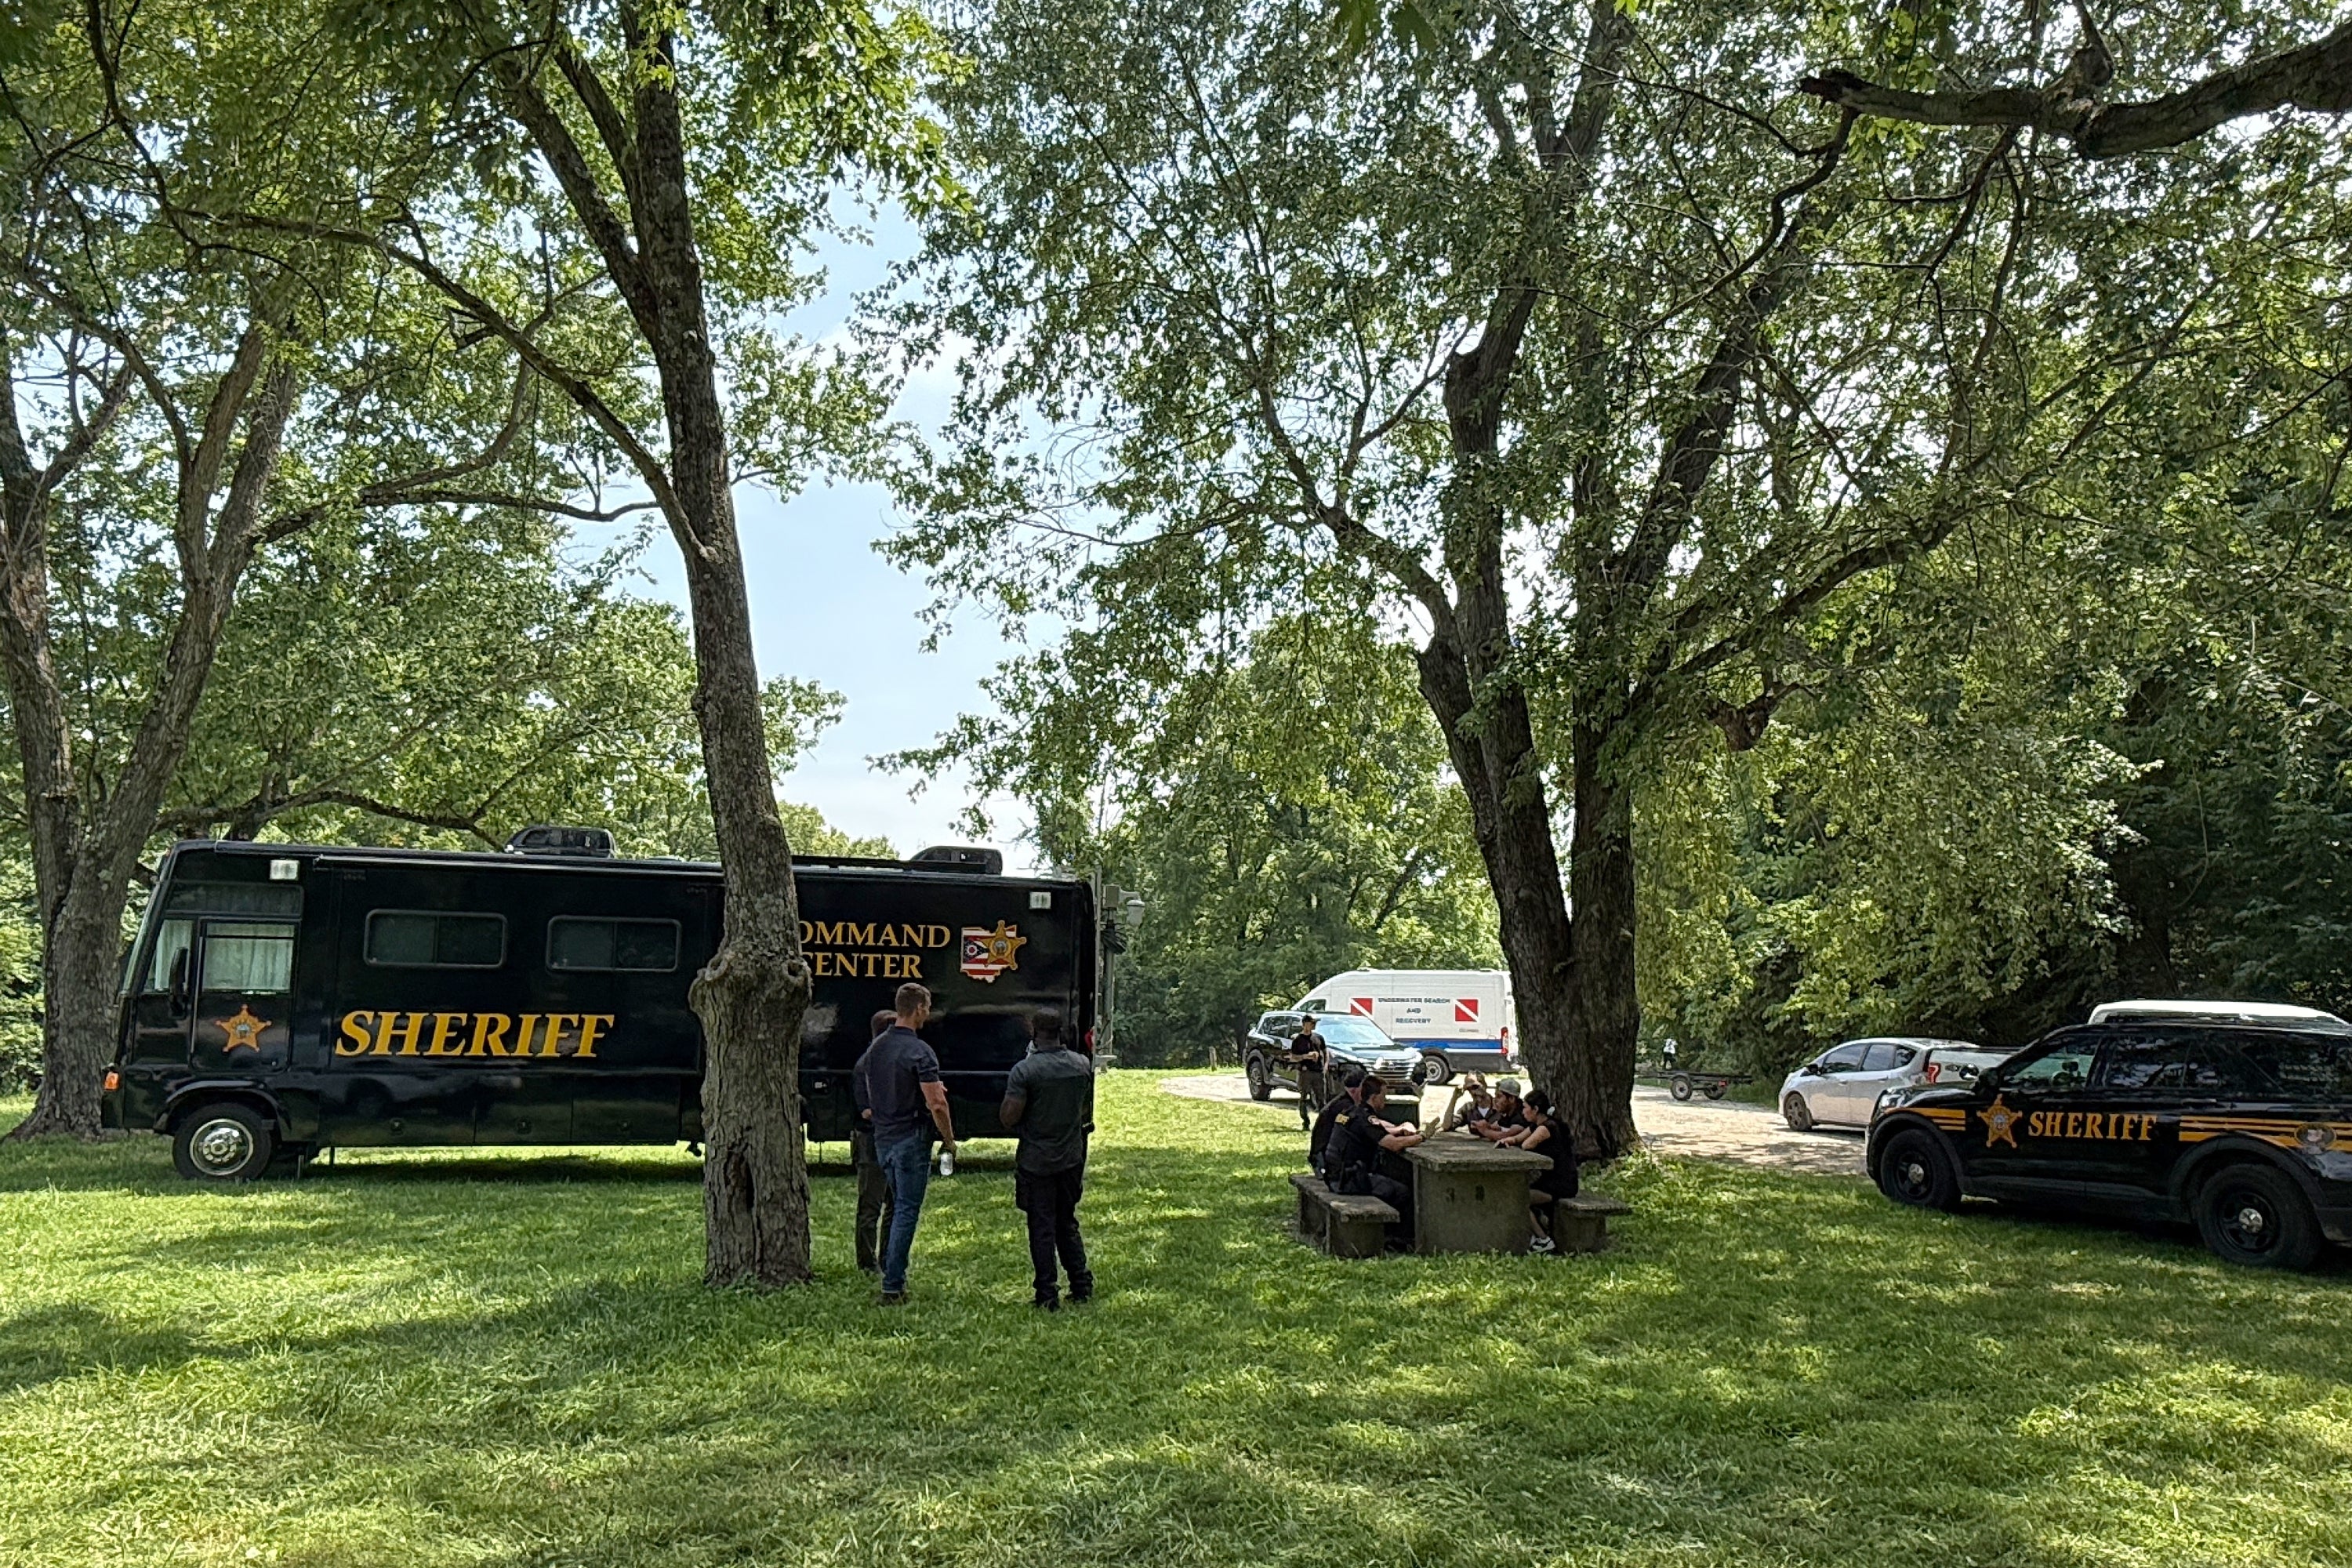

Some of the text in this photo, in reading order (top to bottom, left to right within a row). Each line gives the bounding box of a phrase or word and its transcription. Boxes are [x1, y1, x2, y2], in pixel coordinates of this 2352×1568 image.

[800, 920, 951, 947] OMMAND
[802, 951, 923, 978] ENTER
[335, 1010, 614, 1057] SHERIFF
[2028, 1111, 2158, 1140] SHERIFF
